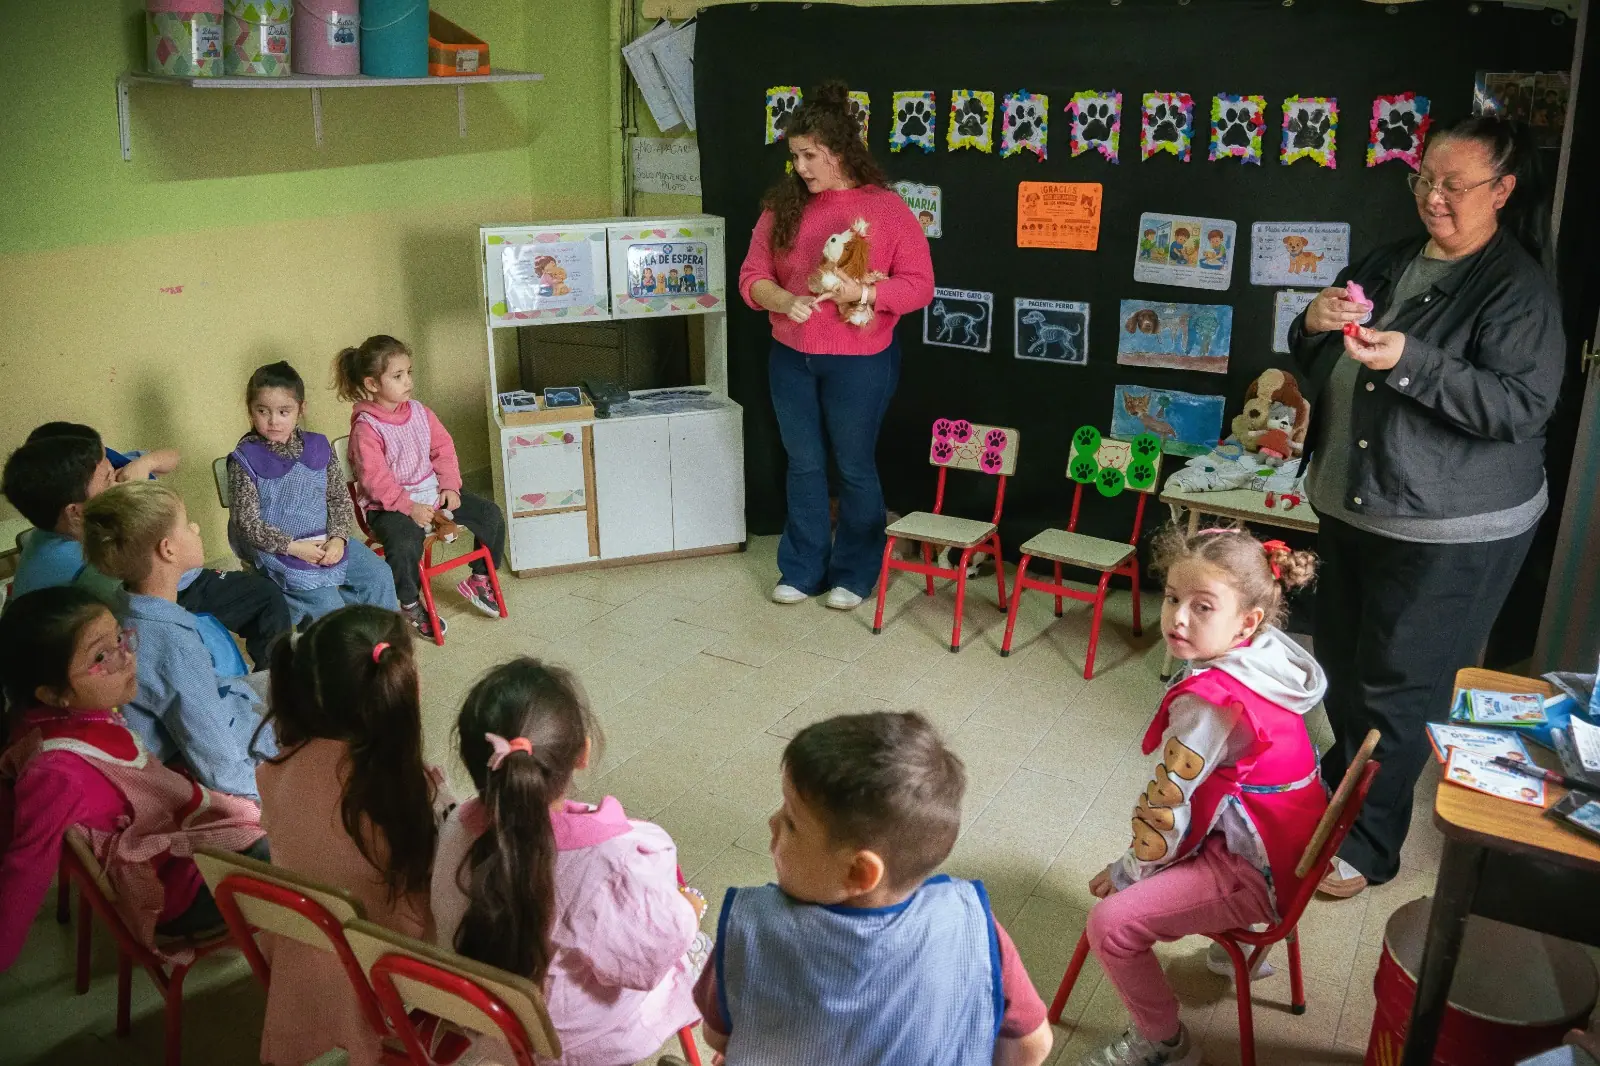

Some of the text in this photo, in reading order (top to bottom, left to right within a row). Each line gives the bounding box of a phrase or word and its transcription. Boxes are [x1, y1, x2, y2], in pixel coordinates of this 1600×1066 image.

[658, 254, 670, 265] DE
[671, 254, 704, 266] ESPERA
[936, 289, 982, 300] PACIENTE: GATO
[1055, 302, 1074, 310] PERRO
